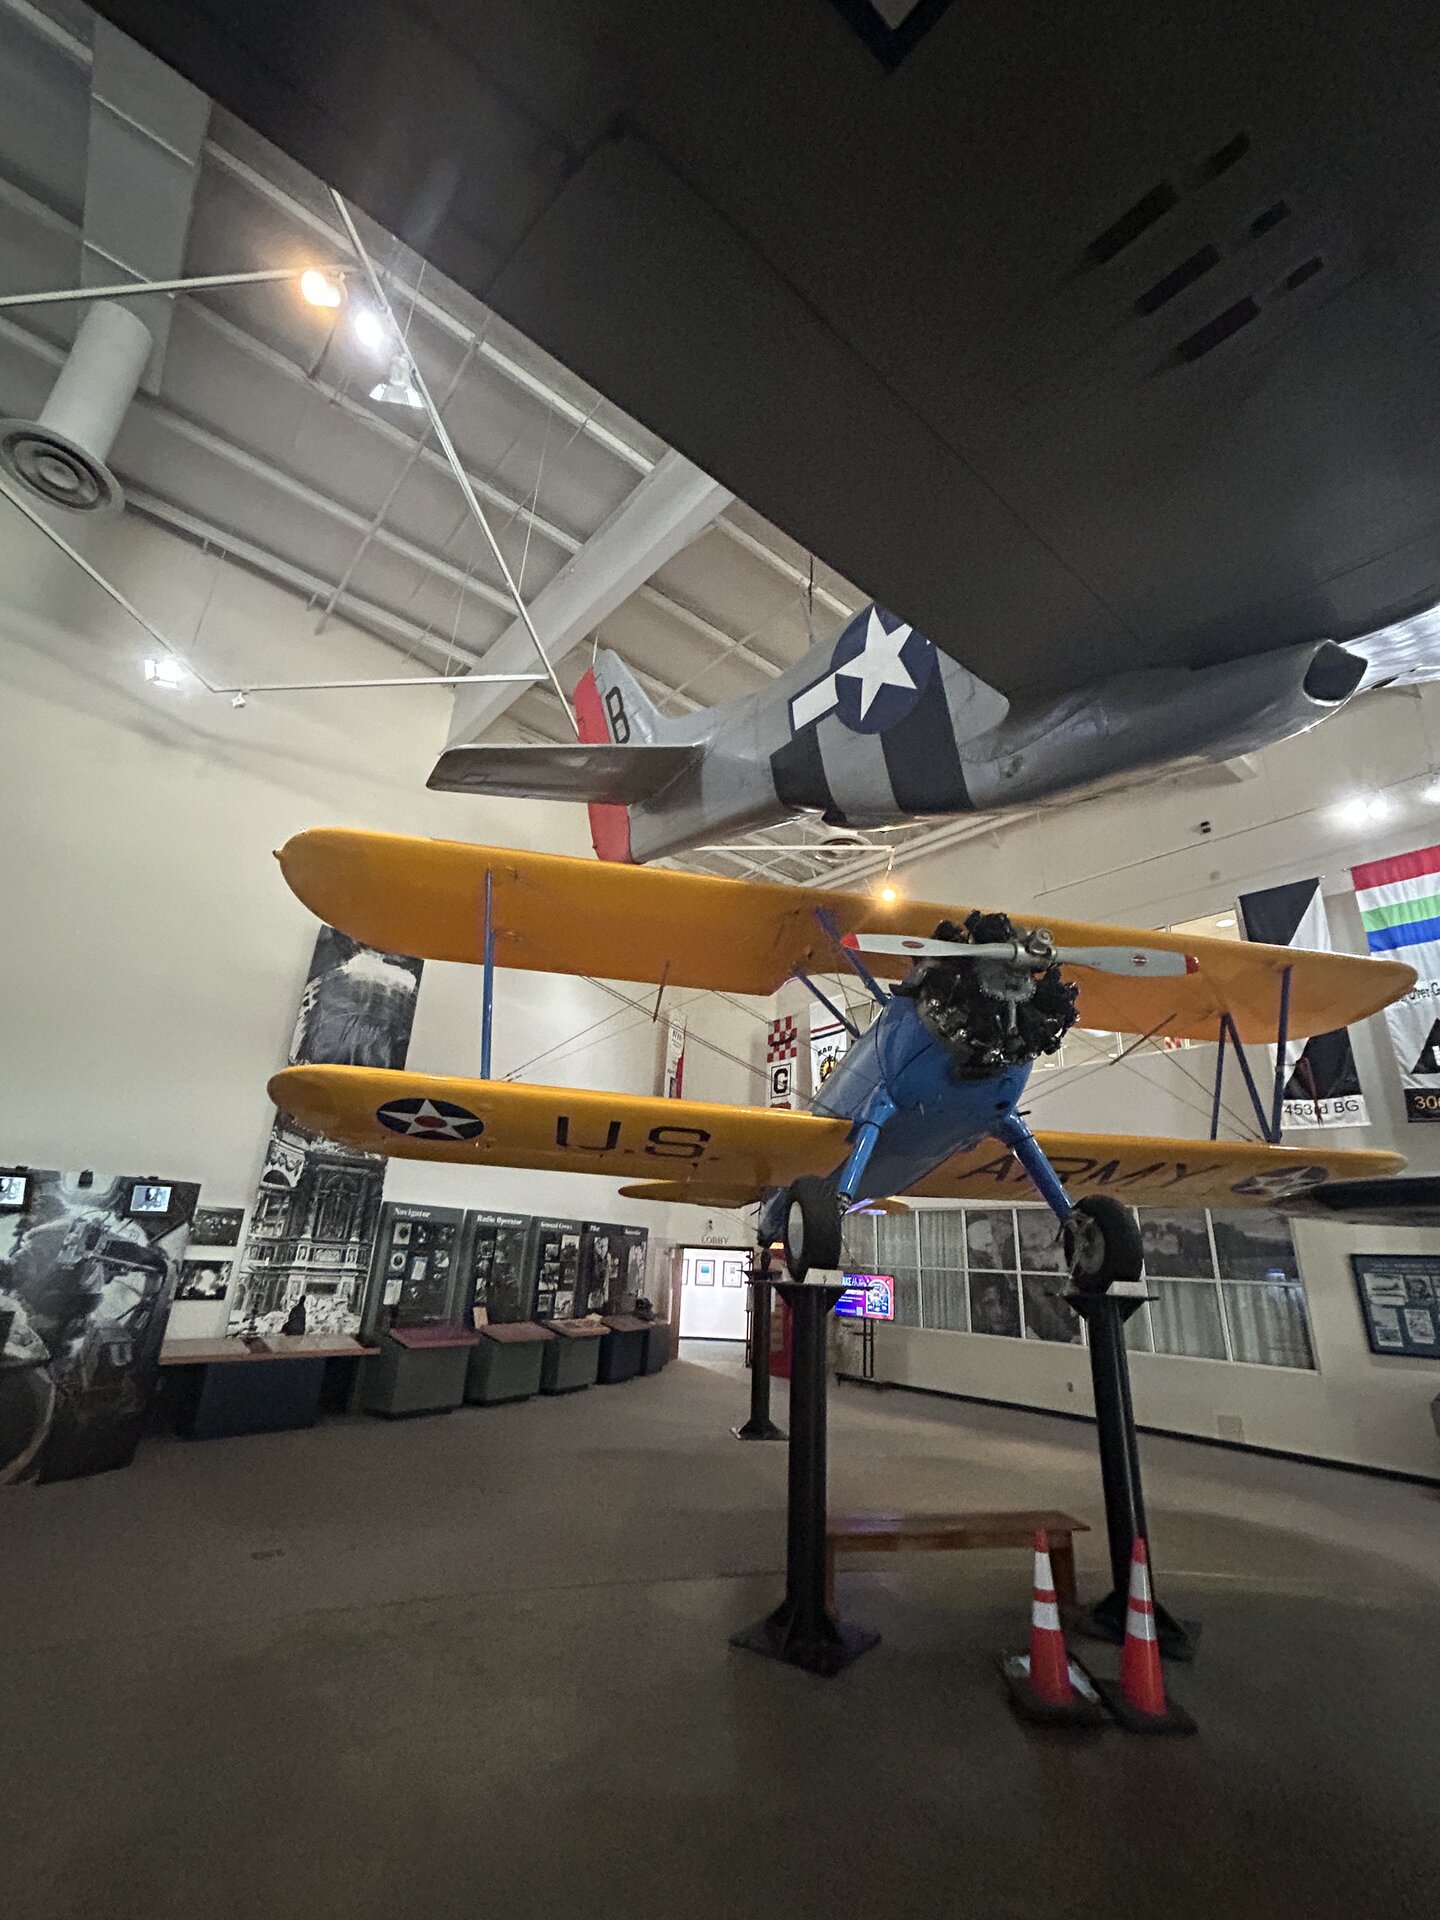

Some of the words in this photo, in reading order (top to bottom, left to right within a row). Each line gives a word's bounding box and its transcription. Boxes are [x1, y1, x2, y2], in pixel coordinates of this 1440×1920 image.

[605, 686, 630, 744] B
[773, 1068, 788, 1094] G
[1334, 1099, 1359, 1114] BG
[1415, 1095, 1440, 1110] 30
[556, 1116, 720, 1161] U.S.
[957, 1153, 1229, 1189] ARMY
[394, 1207, 431, 1218] Navigator
[702, 1235, 729, 1245] LOBBY
